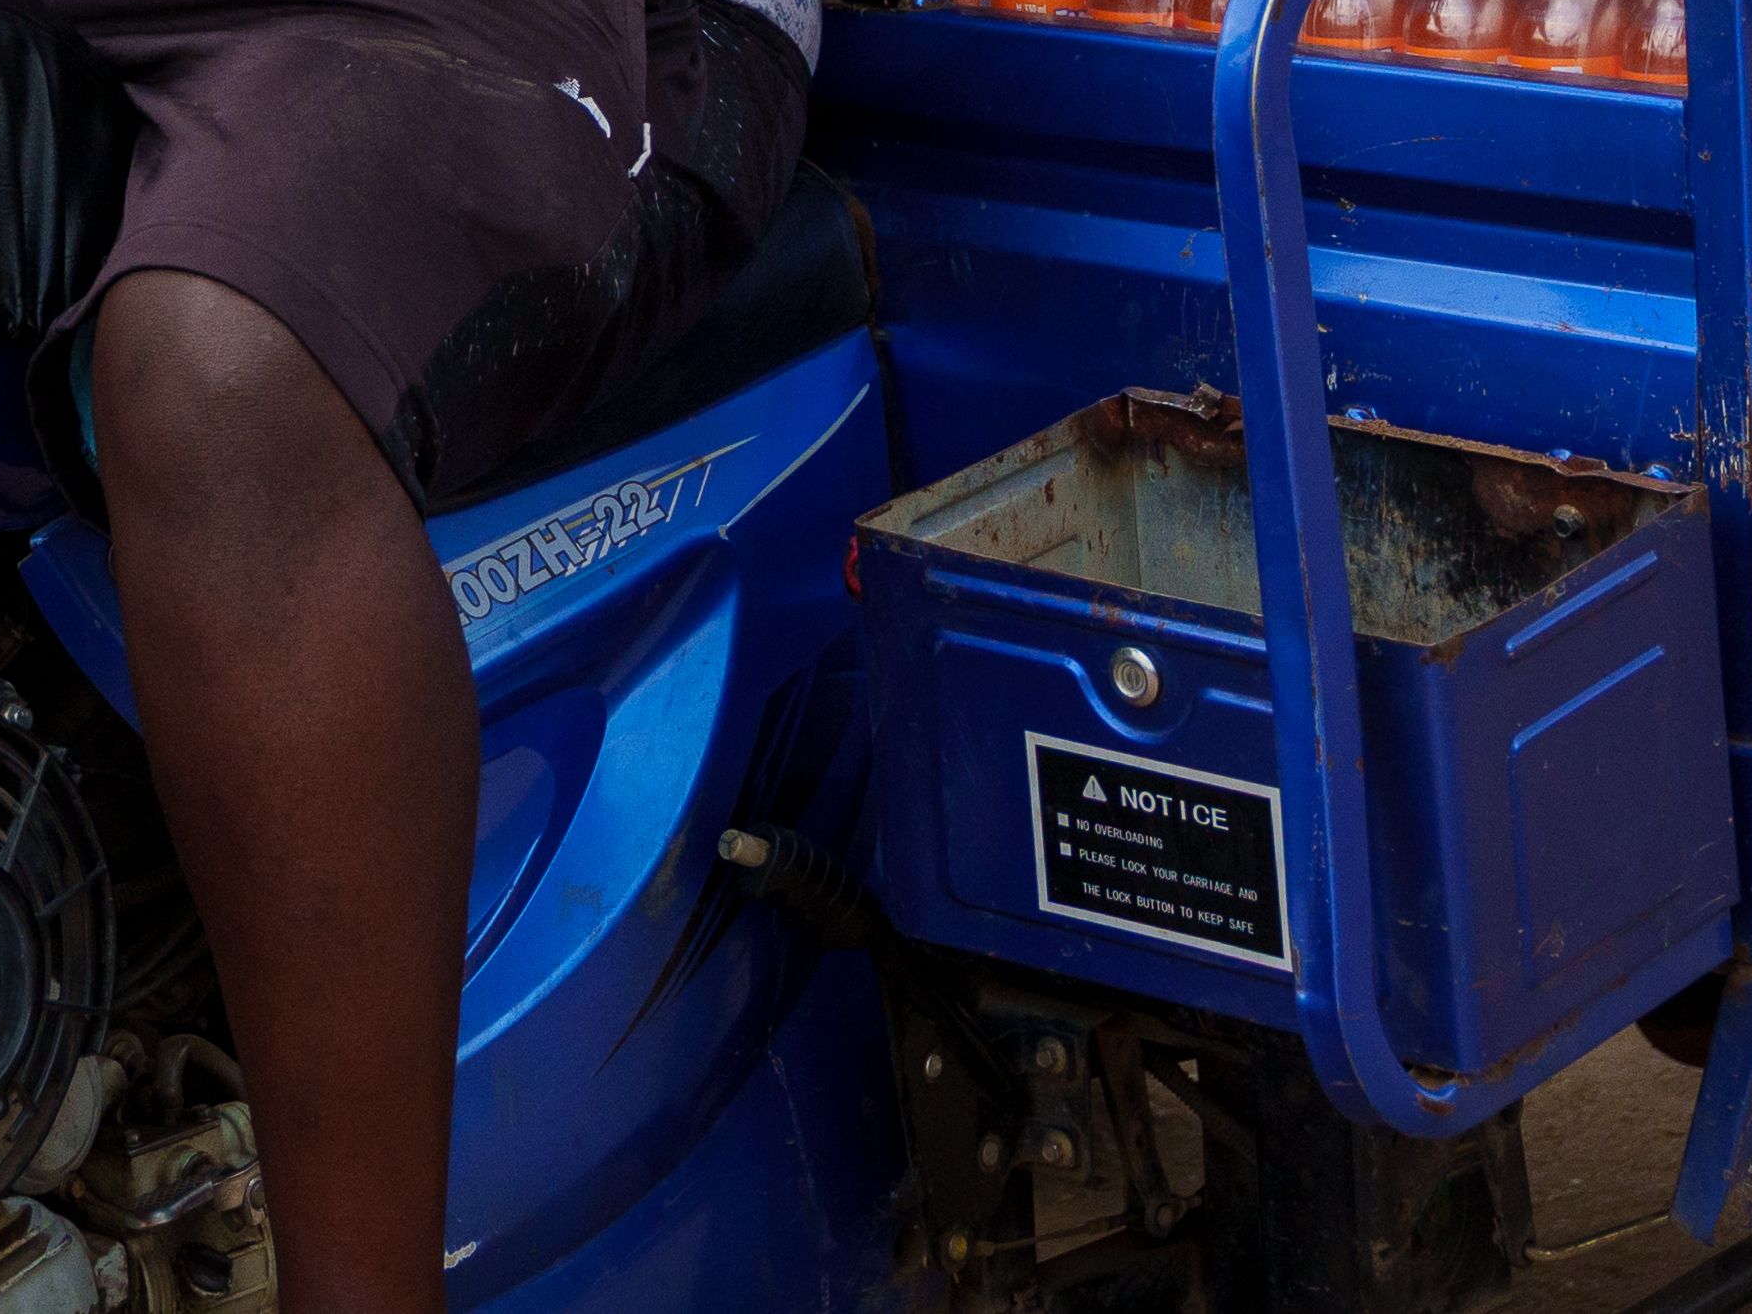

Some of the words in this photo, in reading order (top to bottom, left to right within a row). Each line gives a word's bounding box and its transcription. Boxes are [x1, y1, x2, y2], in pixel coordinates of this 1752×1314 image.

[450, 480, 670, 627] 00ZH-22
[1076, 818, 1090, 832] NO
[1094, 822, 1164, 850] OVERLOADING
[1119, 785, 1230, 831] NOTICE
[1079, 848, 1117, 868] PLEASE
[1121, 858, 1147, 876] LOCK
[1152, 866, 1178, 883] YOUR
[1183, 873, 1233, 897] CARRIAGE
[1238, 886, 1258, 902] AND
[1082, 881, 1101, 898] THE
[1106, 887, 1132, 905] LOCK
[1136, 894, 1175, 915] BUTTON
[1180, 904, 1193, 919] TO
[1198, 909, 1224, 926] KEEP
[1229, 918, 1255, 936] SAFE
